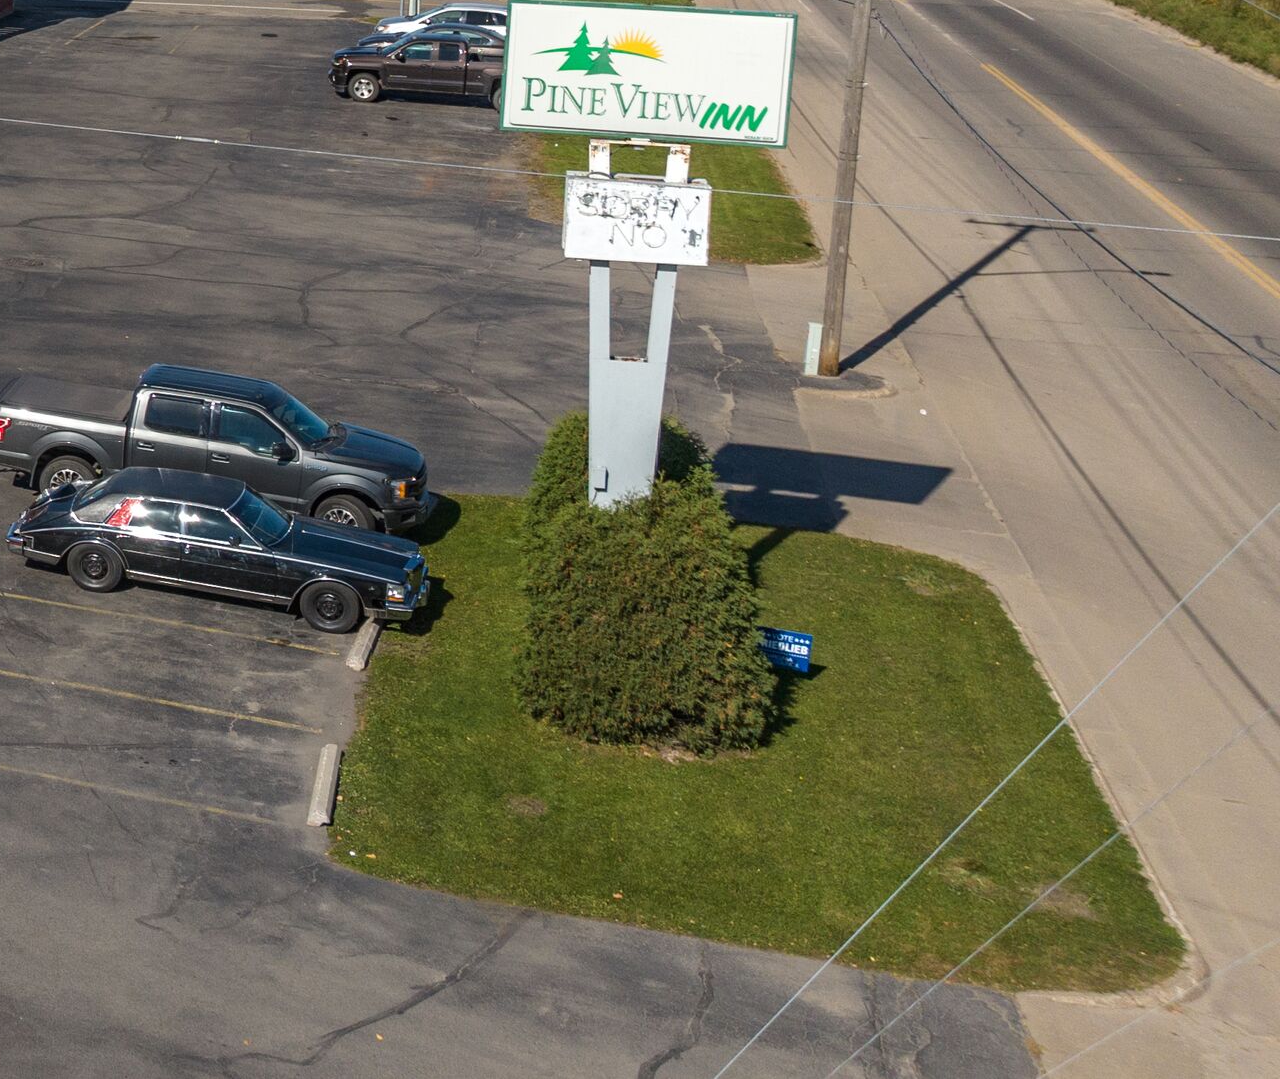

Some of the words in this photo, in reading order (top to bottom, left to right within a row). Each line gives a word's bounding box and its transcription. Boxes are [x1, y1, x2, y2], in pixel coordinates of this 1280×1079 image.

[520, 77, 607, 117] PINE
[610, 83, 706, 123] VIEW
[699, 102, 768, 132] INN
[609, 223, 668, 249] NO
